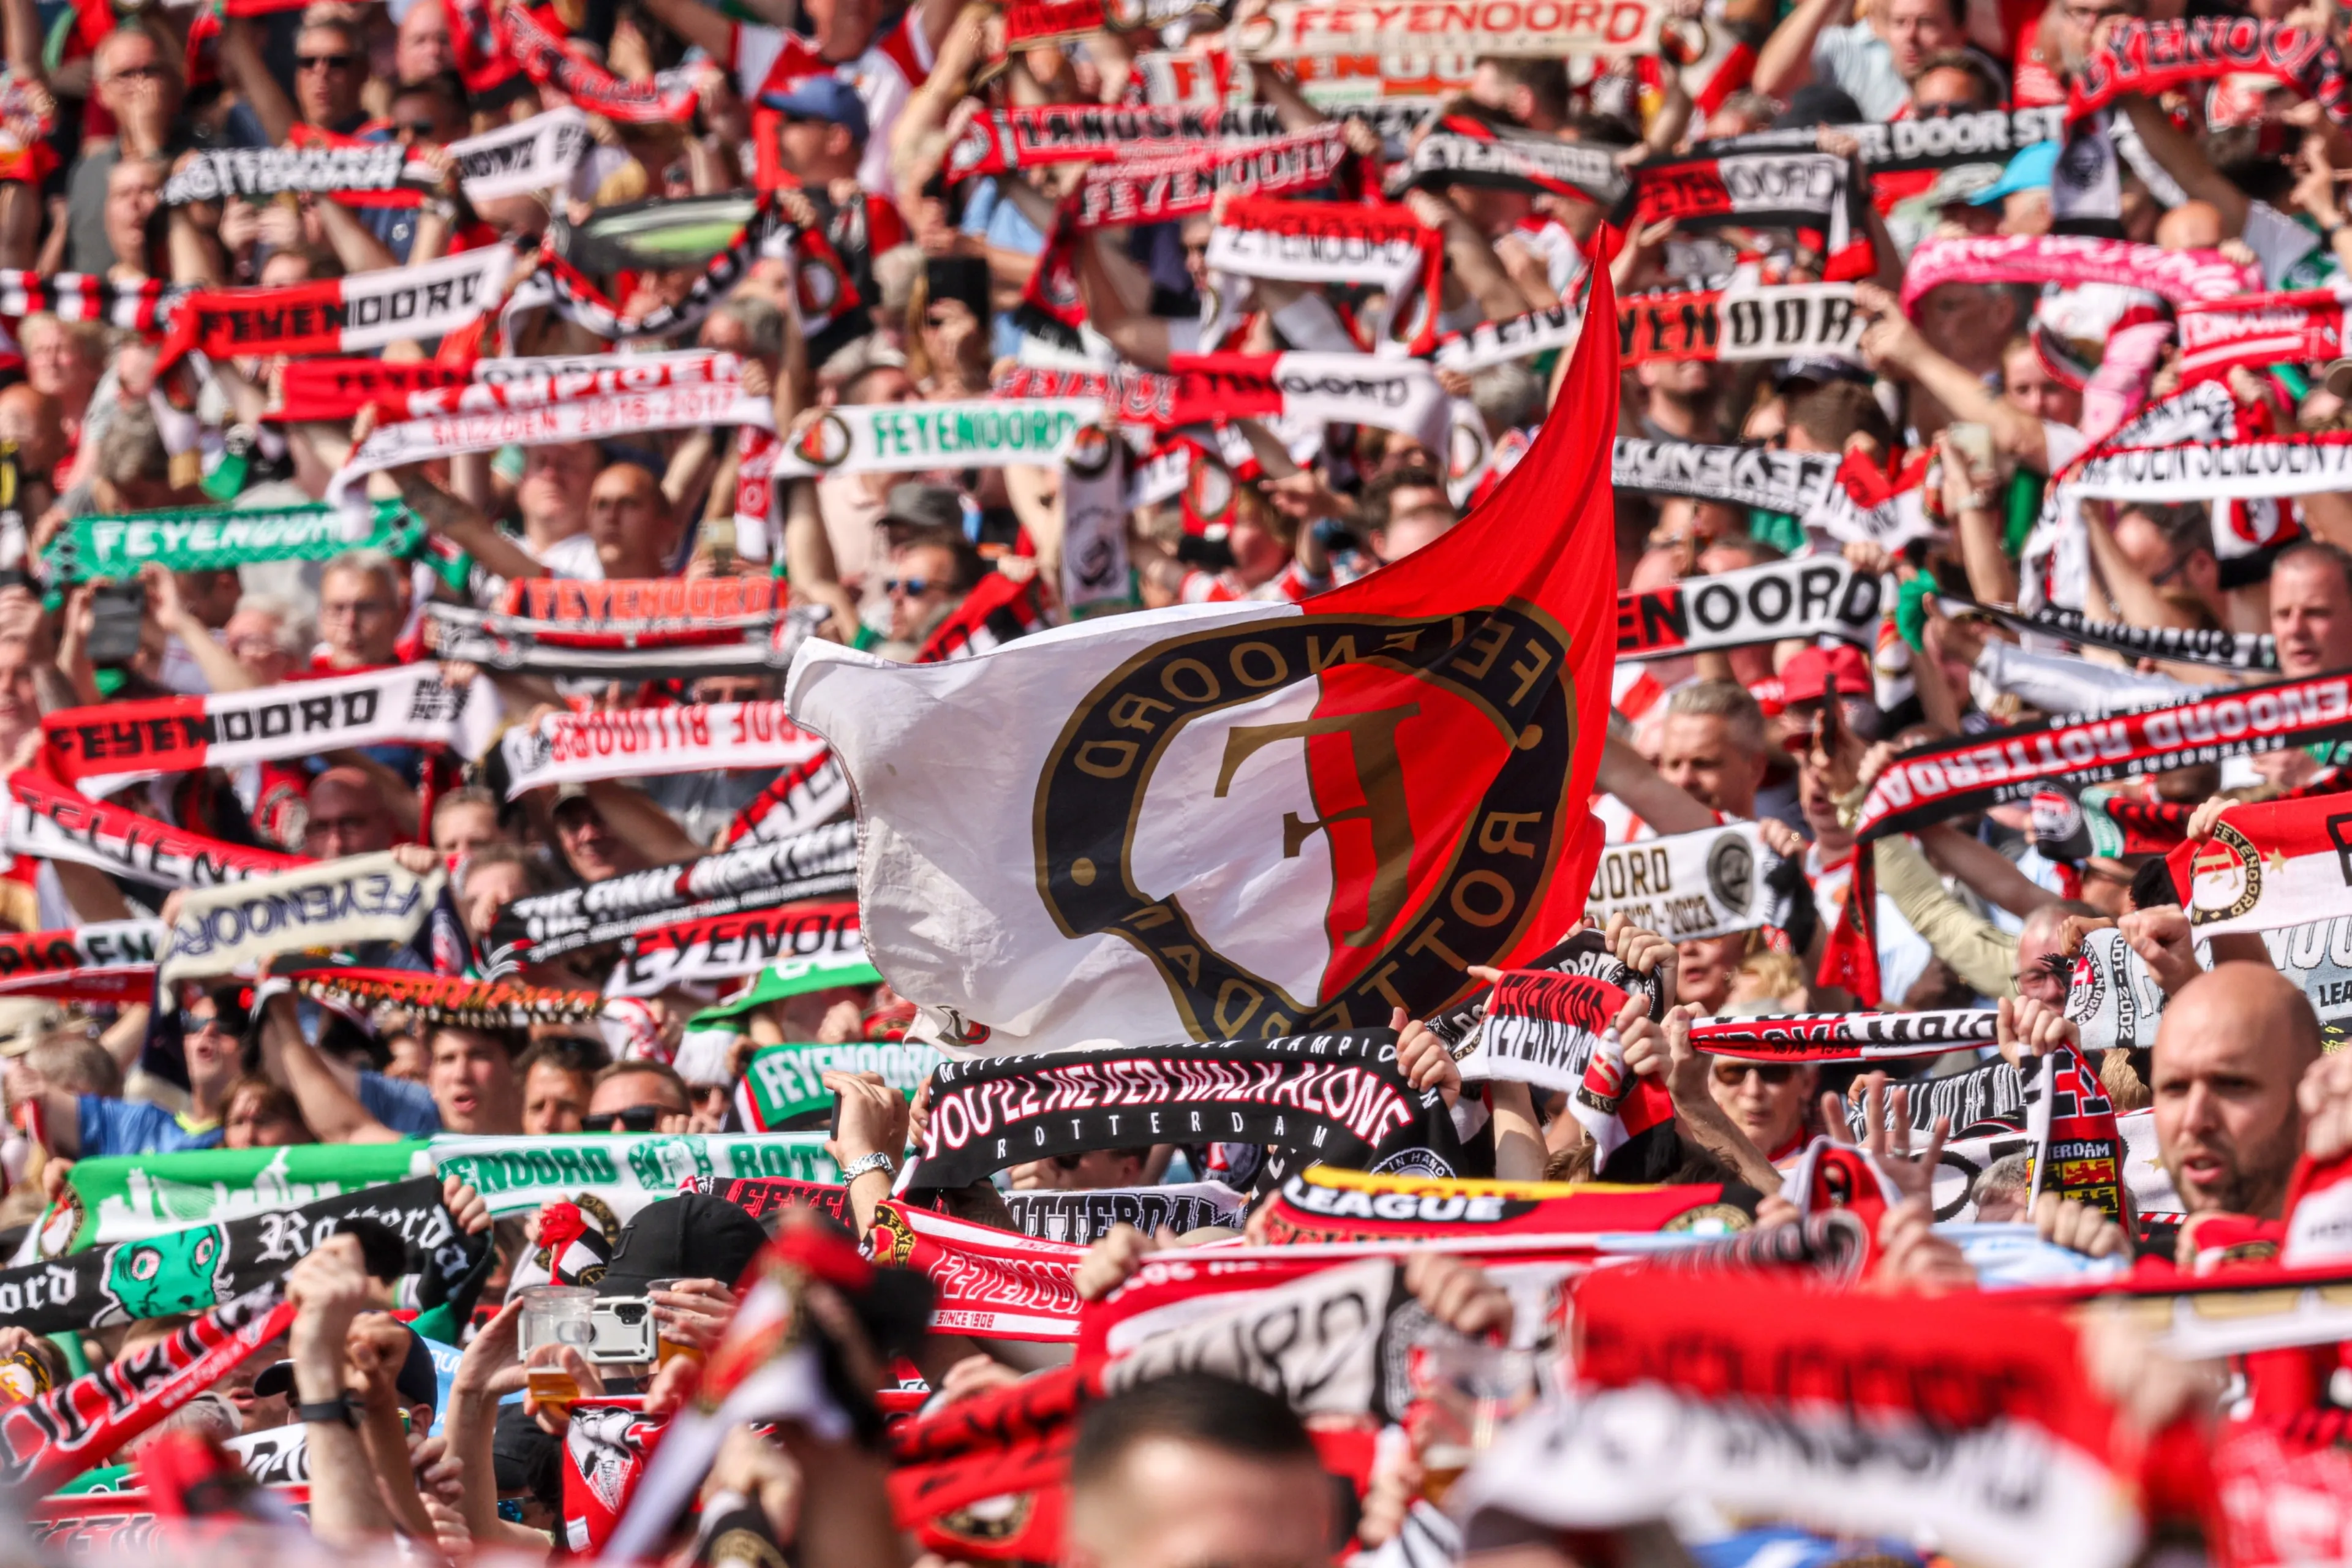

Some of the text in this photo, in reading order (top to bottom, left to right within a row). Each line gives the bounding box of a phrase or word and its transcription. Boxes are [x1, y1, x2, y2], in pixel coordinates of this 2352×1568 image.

[1293, 2, 1648, 45] FEYENOORD
[1893, 111, 2010, 158] DOOR
[2014, 105, 2064, 146] ST
[869, 411, 1078, 458] FEYENOORD
[530, 578, 770, 619] FEYENOORD
[47, 687, 383, 761] FEYENOORD
[2143, 681, 2352, 746] ENOORD
[170, 873, 423, 959] FEYENOOR
[2111, 933, 2135, 1040] 001-2002
[1265, 1035, 1398, 1064] KAMPIO
[922, 1057, 1413, 1161] YOU'LL NEVER WALK ALONE
[997, 1112, 1329, 1159] ROTTERDAM
[437, 1143, 843, 1197] ENOORD ROTT
[1284, 1175, 1506, 1223] LEAGUE
[937, 1311, 996, 1330] SINCE 1908
